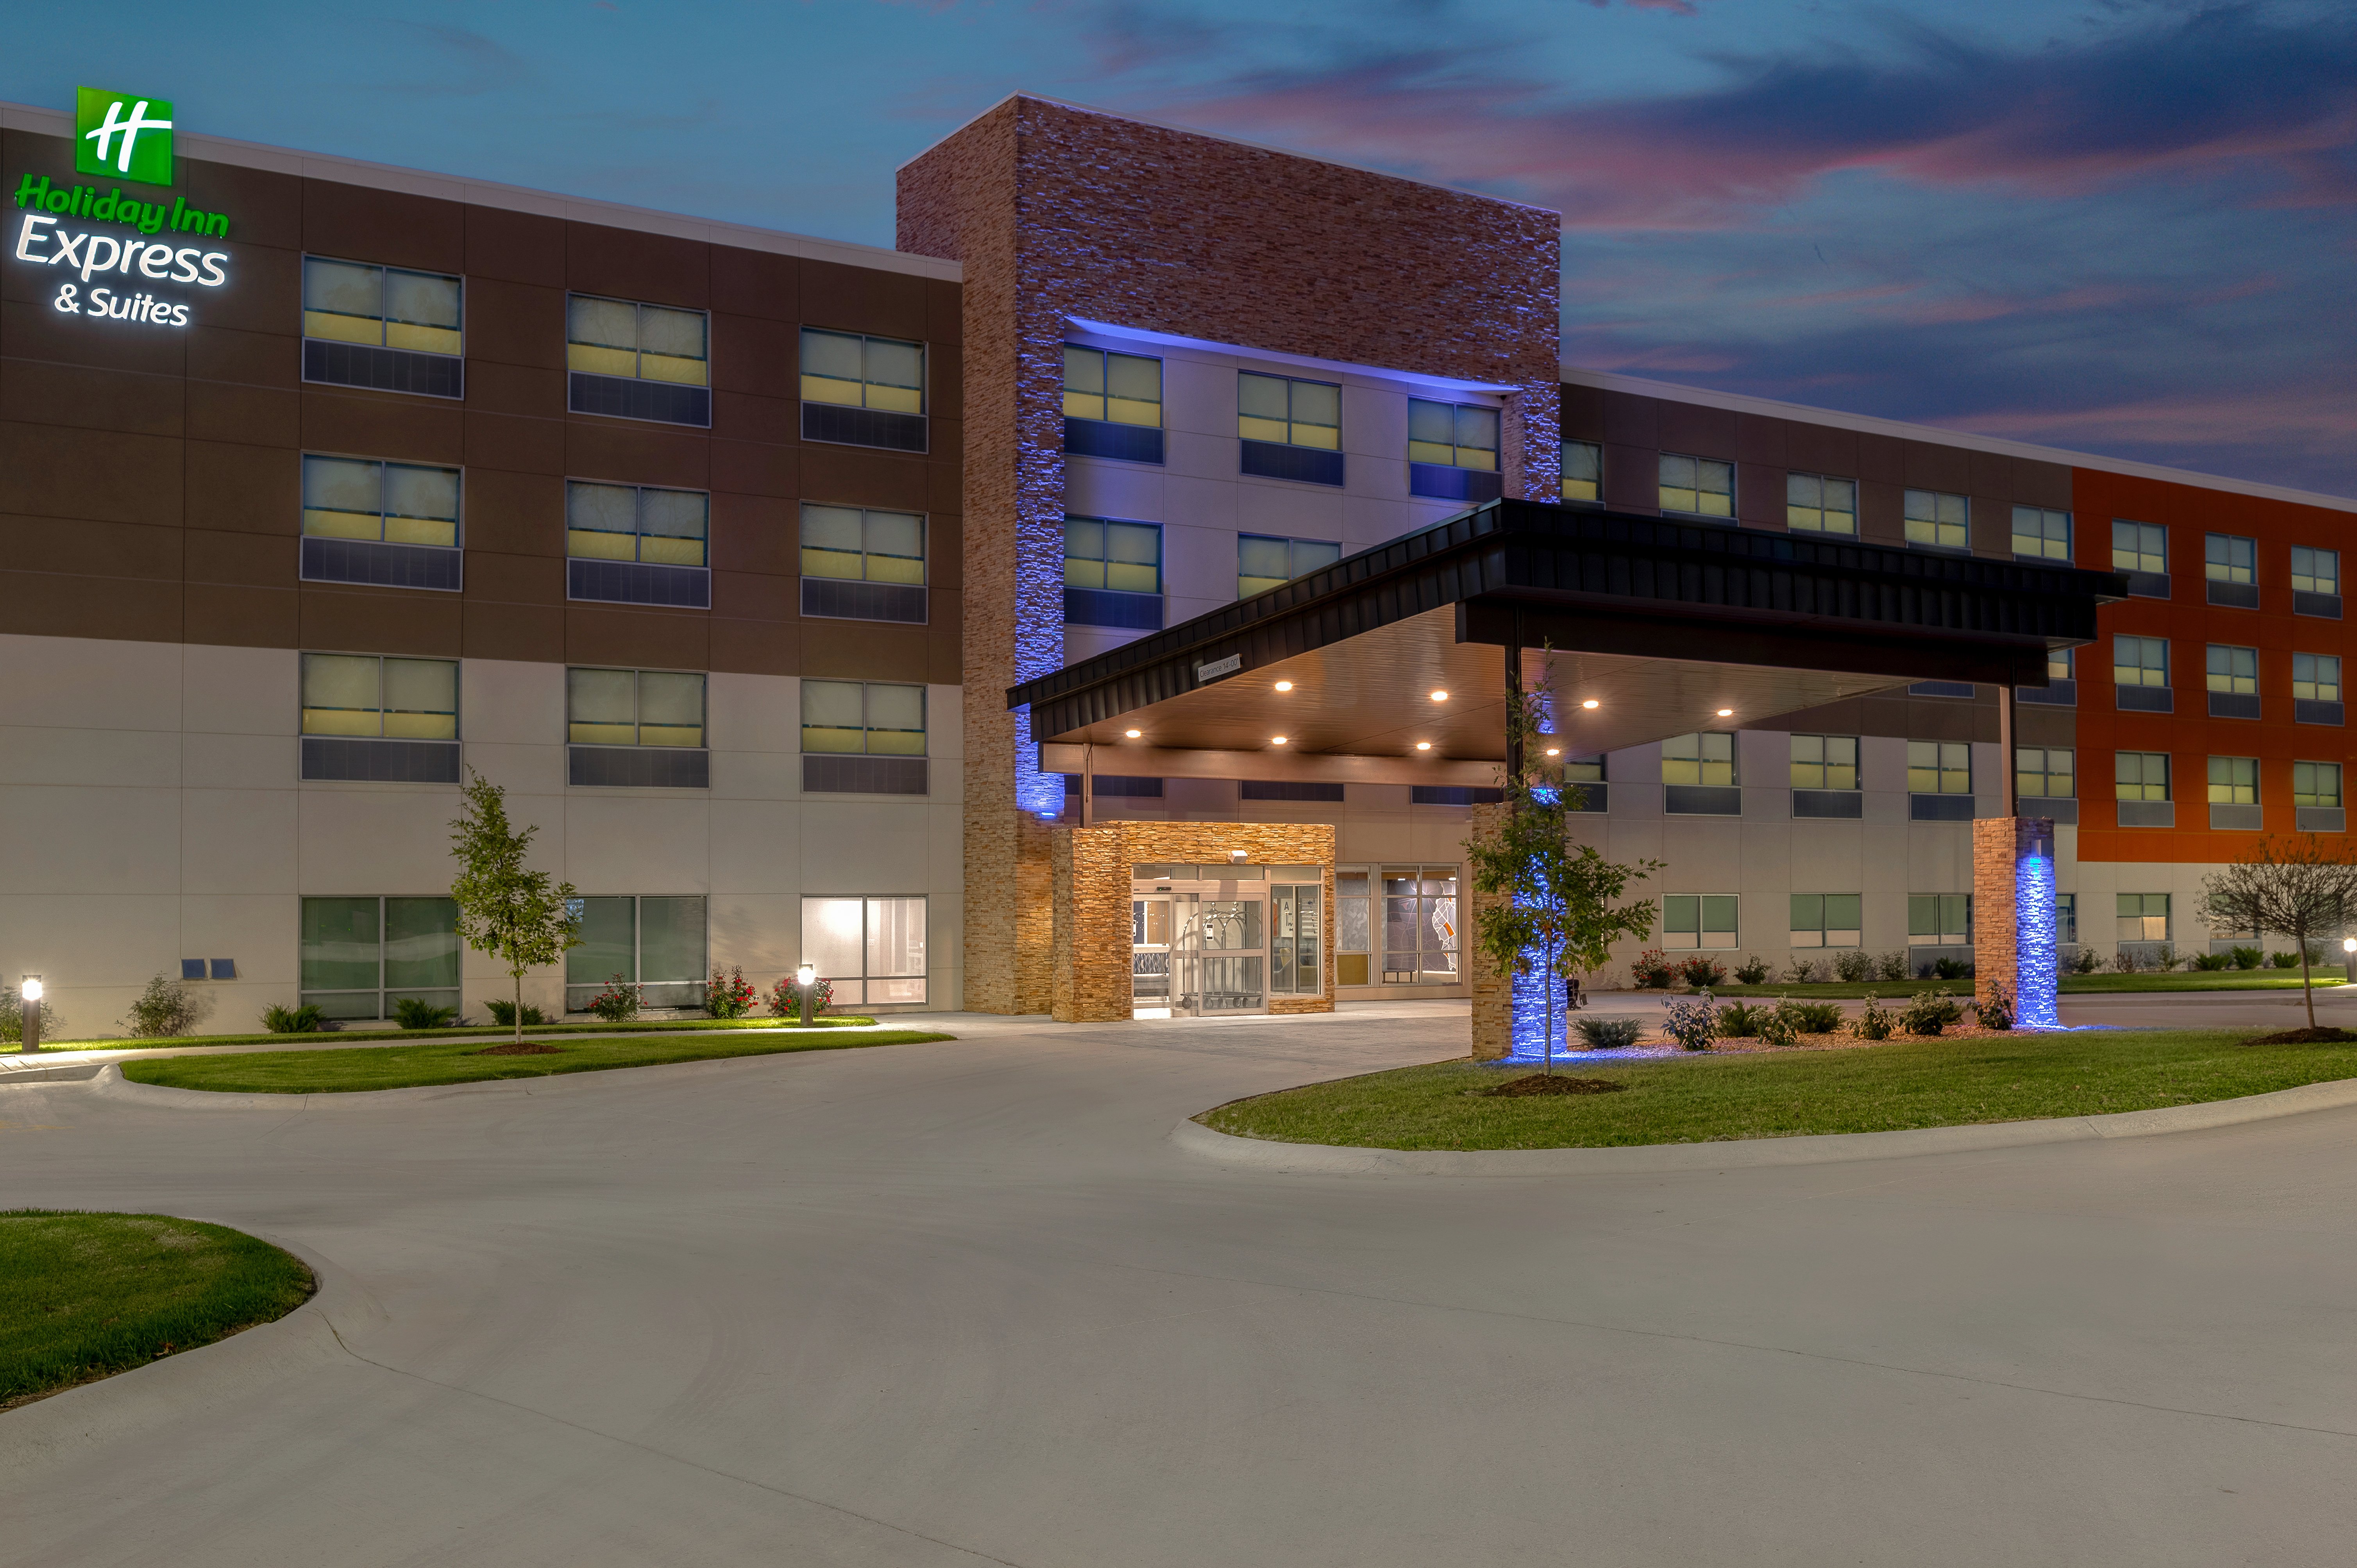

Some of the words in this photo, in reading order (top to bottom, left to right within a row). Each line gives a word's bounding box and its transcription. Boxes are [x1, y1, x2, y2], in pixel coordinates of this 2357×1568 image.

[86, 101, 172, 172] H
[14, 173, 166, 234] Holiday
[170, 196, 230, 237] Inn
[16, 214, 228, 286] Express
[54, 284, 80, 313] &
[87, 288, 190, 326] Suites
[1200, 665, 1222, 678] Clearance
